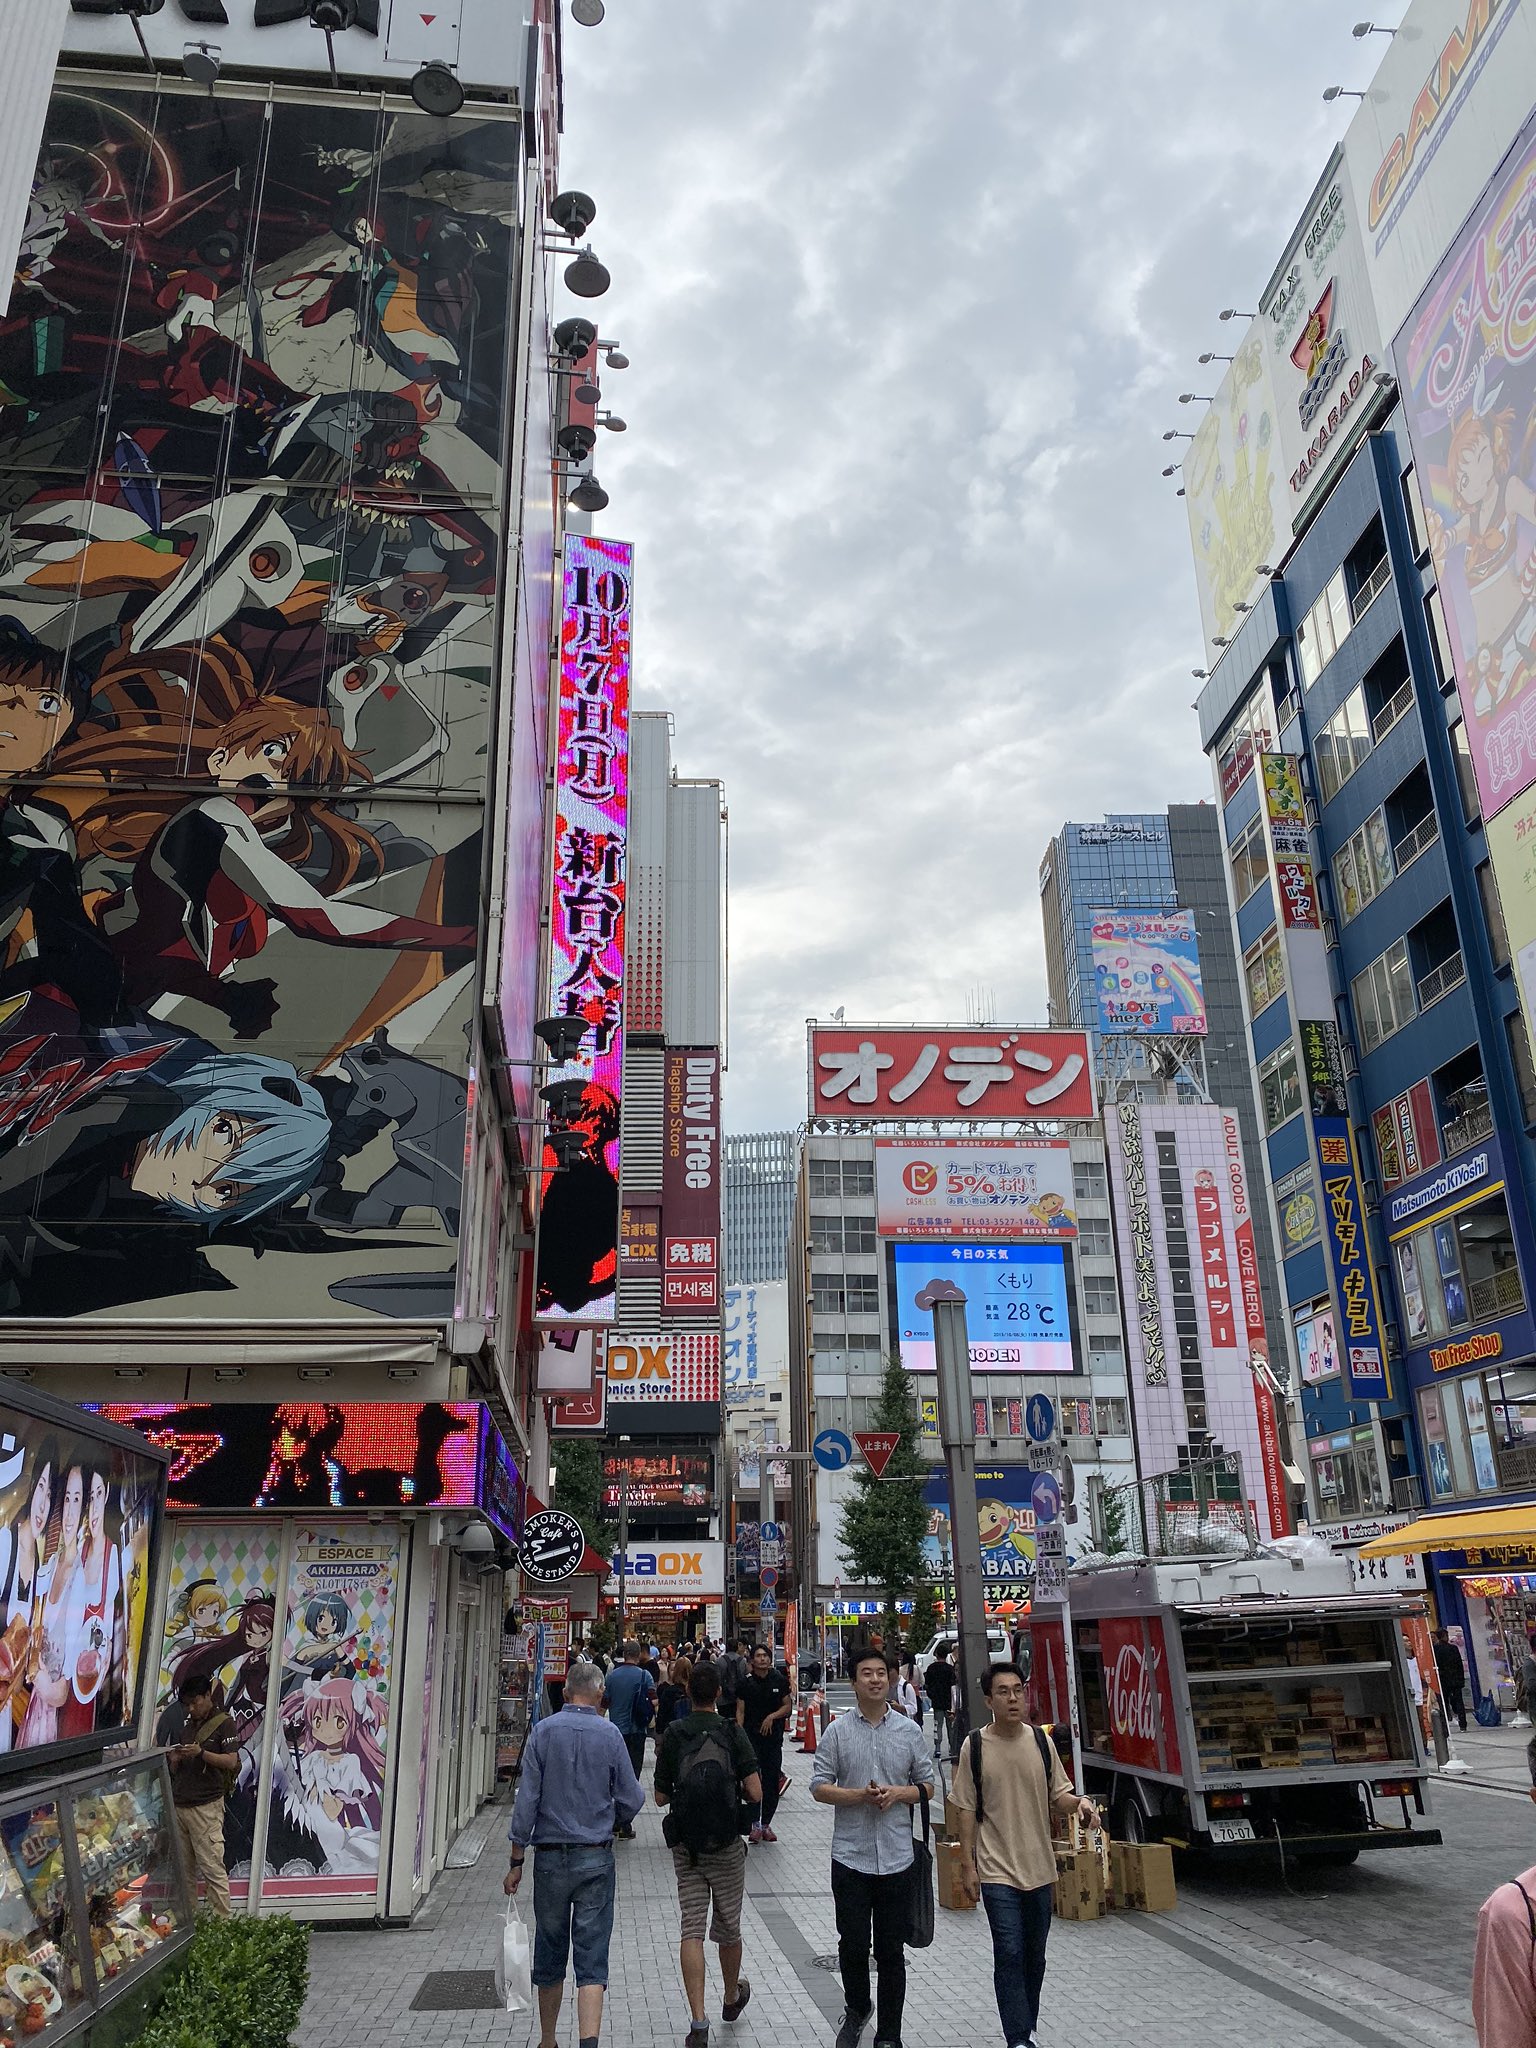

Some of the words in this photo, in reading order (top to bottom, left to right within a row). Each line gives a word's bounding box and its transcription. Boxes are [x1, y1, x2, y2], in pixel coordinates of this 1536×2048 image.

[1270, 265, 1300, 323] TAX
[1304, 183, 1342, 260] FREE
[1290, 354, 1378, 494] TAKARADA
[1275, 838, 1309, 853] 麻雀
[1119, 1001, 1159, 1013] LOVE
[818, 1033, 1084, 1107] オノデン
[669, 1057, 683, 1114] Flagship
[683, 1057, 716, 1122] Duty
[670, 1117, 683, 1158] Store
[1223, 1115, 1239, 1159] ADULT
[685, 1126, 713, 1189] Free
[1321, 1139, 1348, 1164] 薬
[946, 1162, 1036, 1175] カードで払って
[1228, 1162, 1247, 1215] GOODS
[906, 1197, 936, 1205] CASHLESS
[670, 1243, 712, 1263] 免税
[951, 1248, 1008, 1260] 今日の天気
[1239, 1238, 1255, 1274] LOVE
[997, 1272, 1033, 1289] くもり
[668, 1281, 713, 1298] 면세점
[1243, 1278, 1262, 1329] MERCI
[746, 1289, 757, 1379] オーディオ専門店
[1430, 1346, 1449, 1372] Tax
[1448, 1341, 1473, 1365] Free
[1471, 1333, 1502, 1358] Shop
[1356, 1362, 1377, 1373] 免税
[640, 1382, 672, 1395] Store
[863, 1441, 892, 1452] 止まれ
[1032, 1458, 1054, 1470] 16-19
[524, 1514, 579, 1538] SMOKER'S
[540, 1527, 564, 1540] Cafe
[318, 1548, 374, 1559] ESPACE
[1037, 1540, 1063, 1550] 一方通行
[523, 1554, 544, 1578] VAPE
[545, 1555, 578, 1578] STAND
[1404, 1554, 1414, 1566] 24
[311, 1566, 376, 1575] AKIHABARA
[531, 1606, 560, 1619] セール
[1220, 1828, 1250, 1840] 70-07
